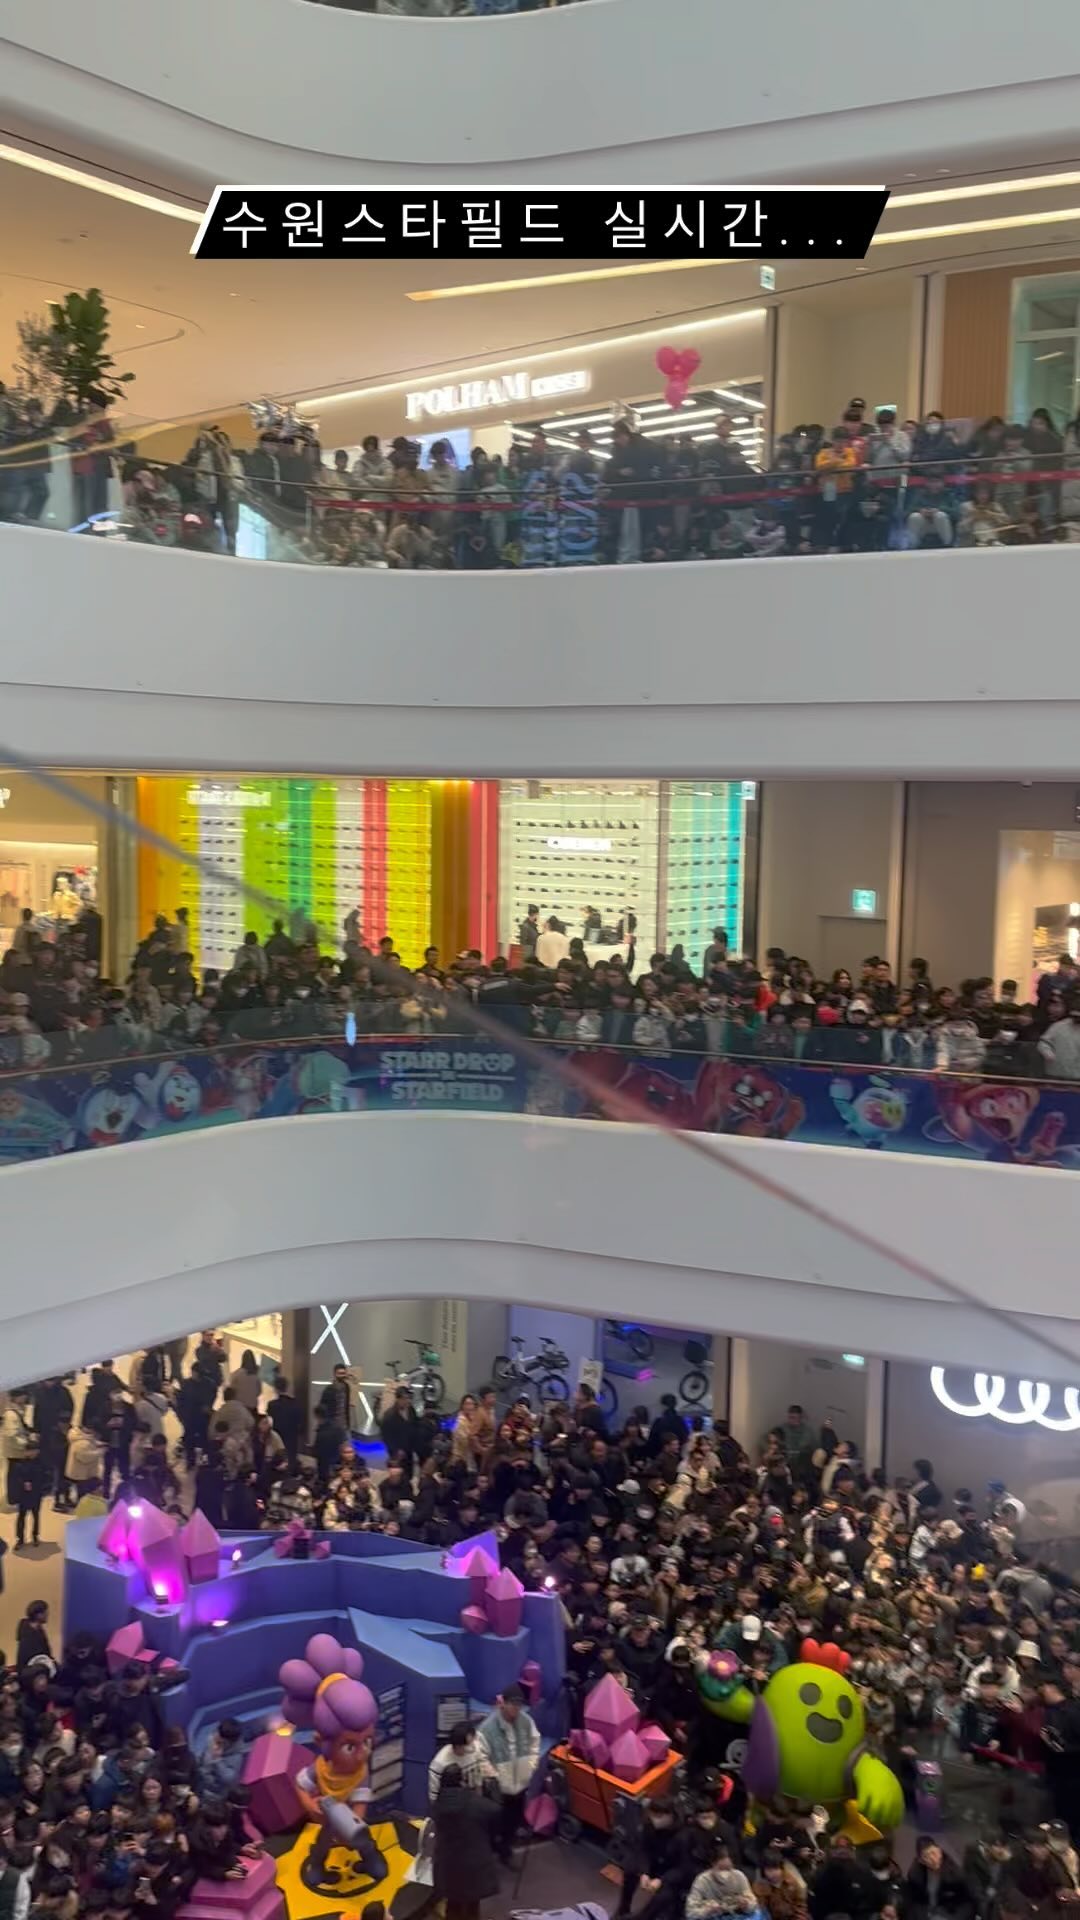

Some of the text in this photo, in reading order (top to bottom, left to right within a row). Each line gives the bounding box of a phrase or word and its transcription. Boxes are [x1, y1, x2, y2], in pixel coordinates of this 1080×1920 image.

[405, 372, 529, 420] POLHAM
[380, 1051, 515, 1072] STARR DROP
[391, 1081, 503, 1101] STARFIELD
